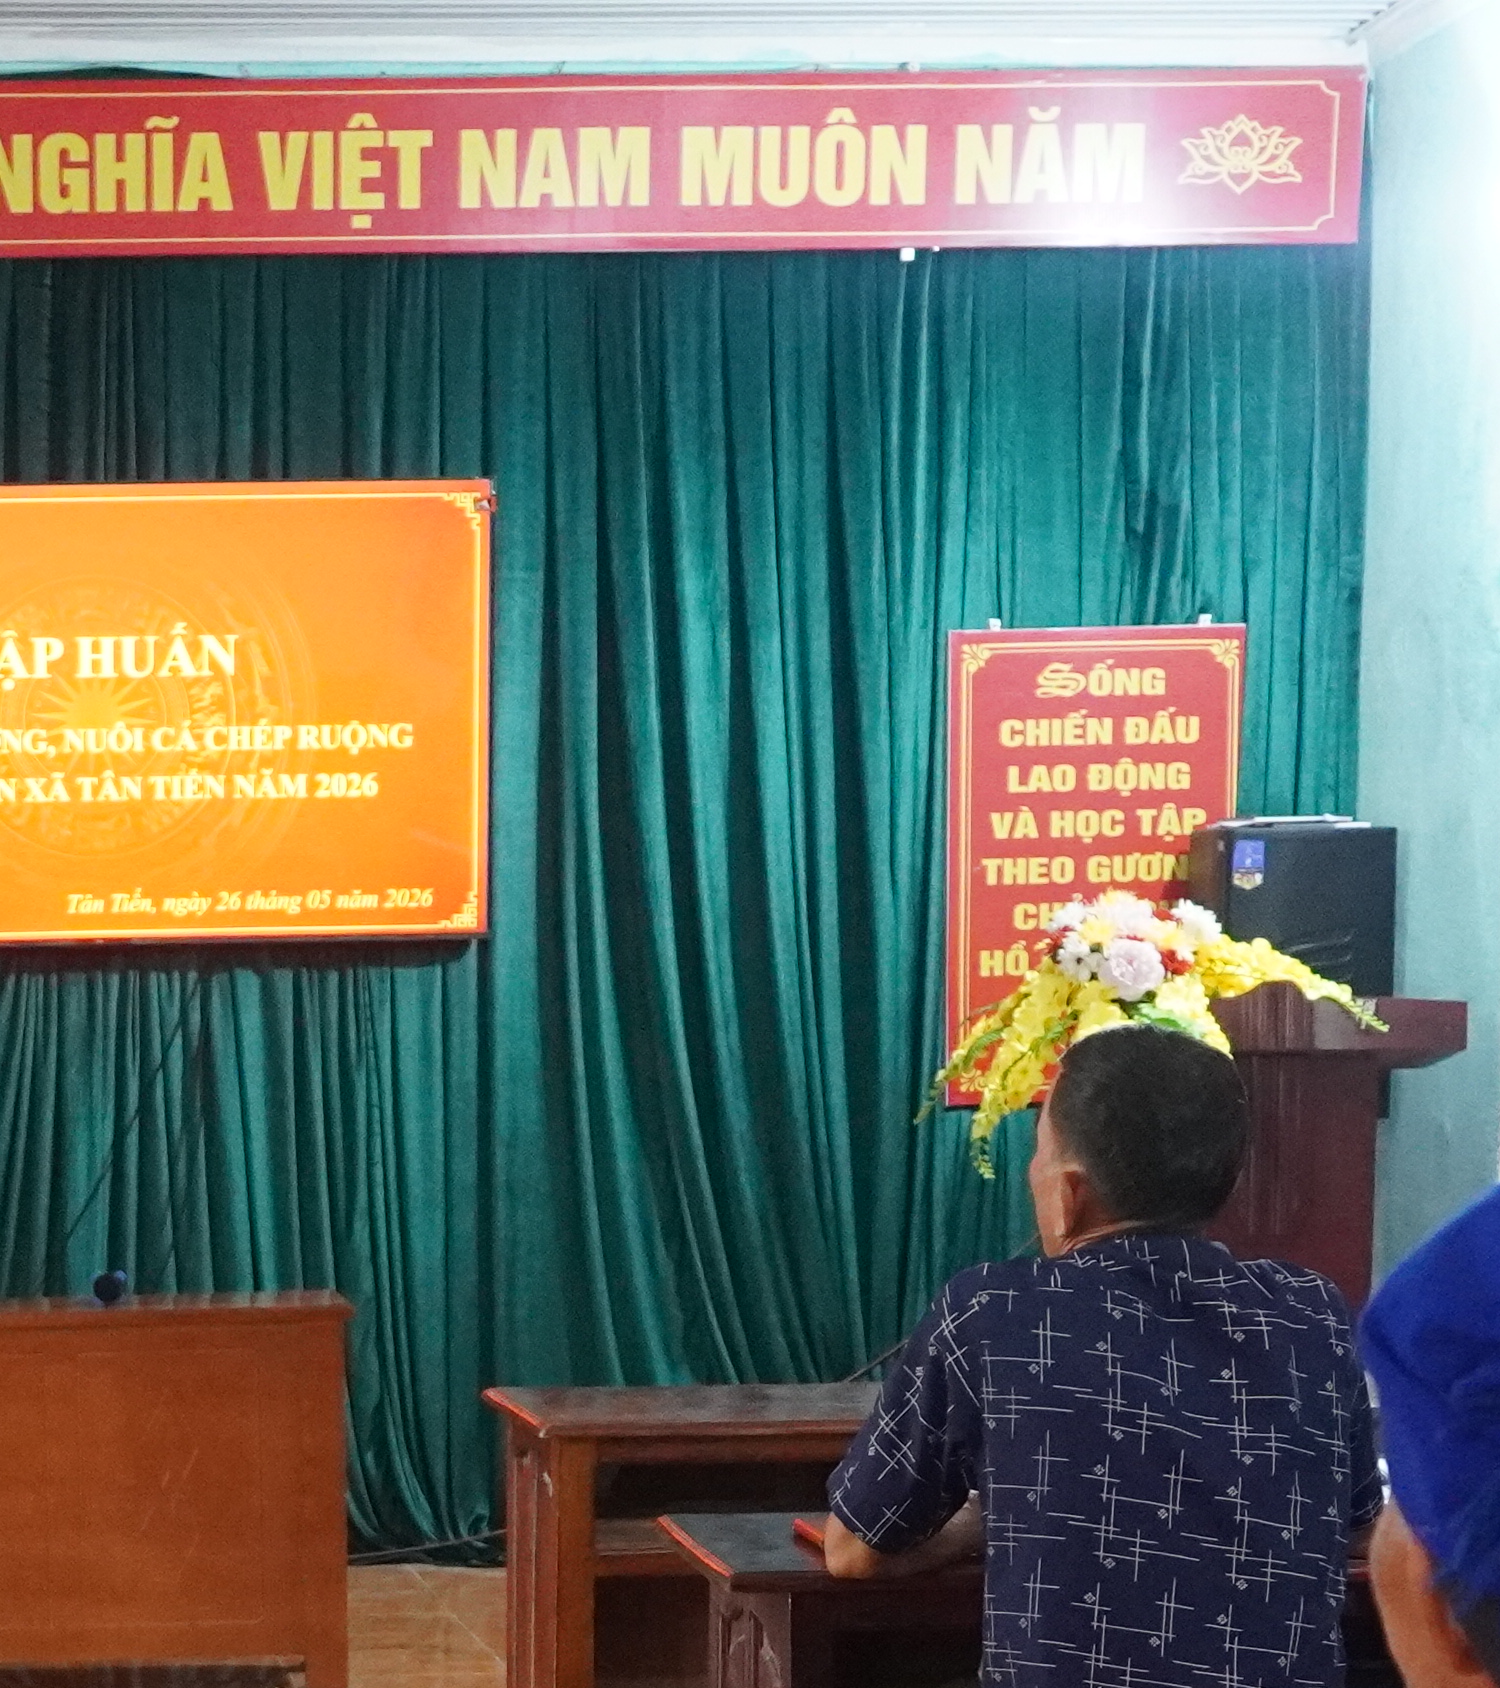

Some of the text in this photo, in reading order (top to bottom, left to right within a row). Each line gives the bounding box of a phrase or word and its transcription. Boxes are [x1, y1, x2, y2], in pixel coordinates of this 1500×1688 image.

[258, 112, 434, 229] VIỆT
[459, 126, 652, 209] NAM
[680, 107, 928, 208] MUÔN
[955, 105, 1146, 205] NĂM
[74, 621, 239, 678] HUẤN
[1035, 658, 1167, 699] SỐNG
[63, 720, 145, 752] NUÔI
[149, 719, 198, 751] CÁ
[203, 718, 293, 750] CHÉP
[296, 720, 415, 755] RUỘNG
[1000, 706, 1200, 748] CHIẾN ĐẤU
[23, 771, 72, 803] XÃ
[76, 769, 143, 801] TÂN
[233, 767, 308, 799] NĂM
[313, 771, 379, 799] 2026
[1007, 757, 1191, 797] LAO ĐỘNG
[990, 802, 1207, 846] VÀ HỌC TẬP
[981, 851, 1189, 886] THEO GƯƠN
[66, 887, 434, 917] Tân Tiến, ngày 26 tháng 05 năm 2026
[979, 939, 1030, 977] HỒ
